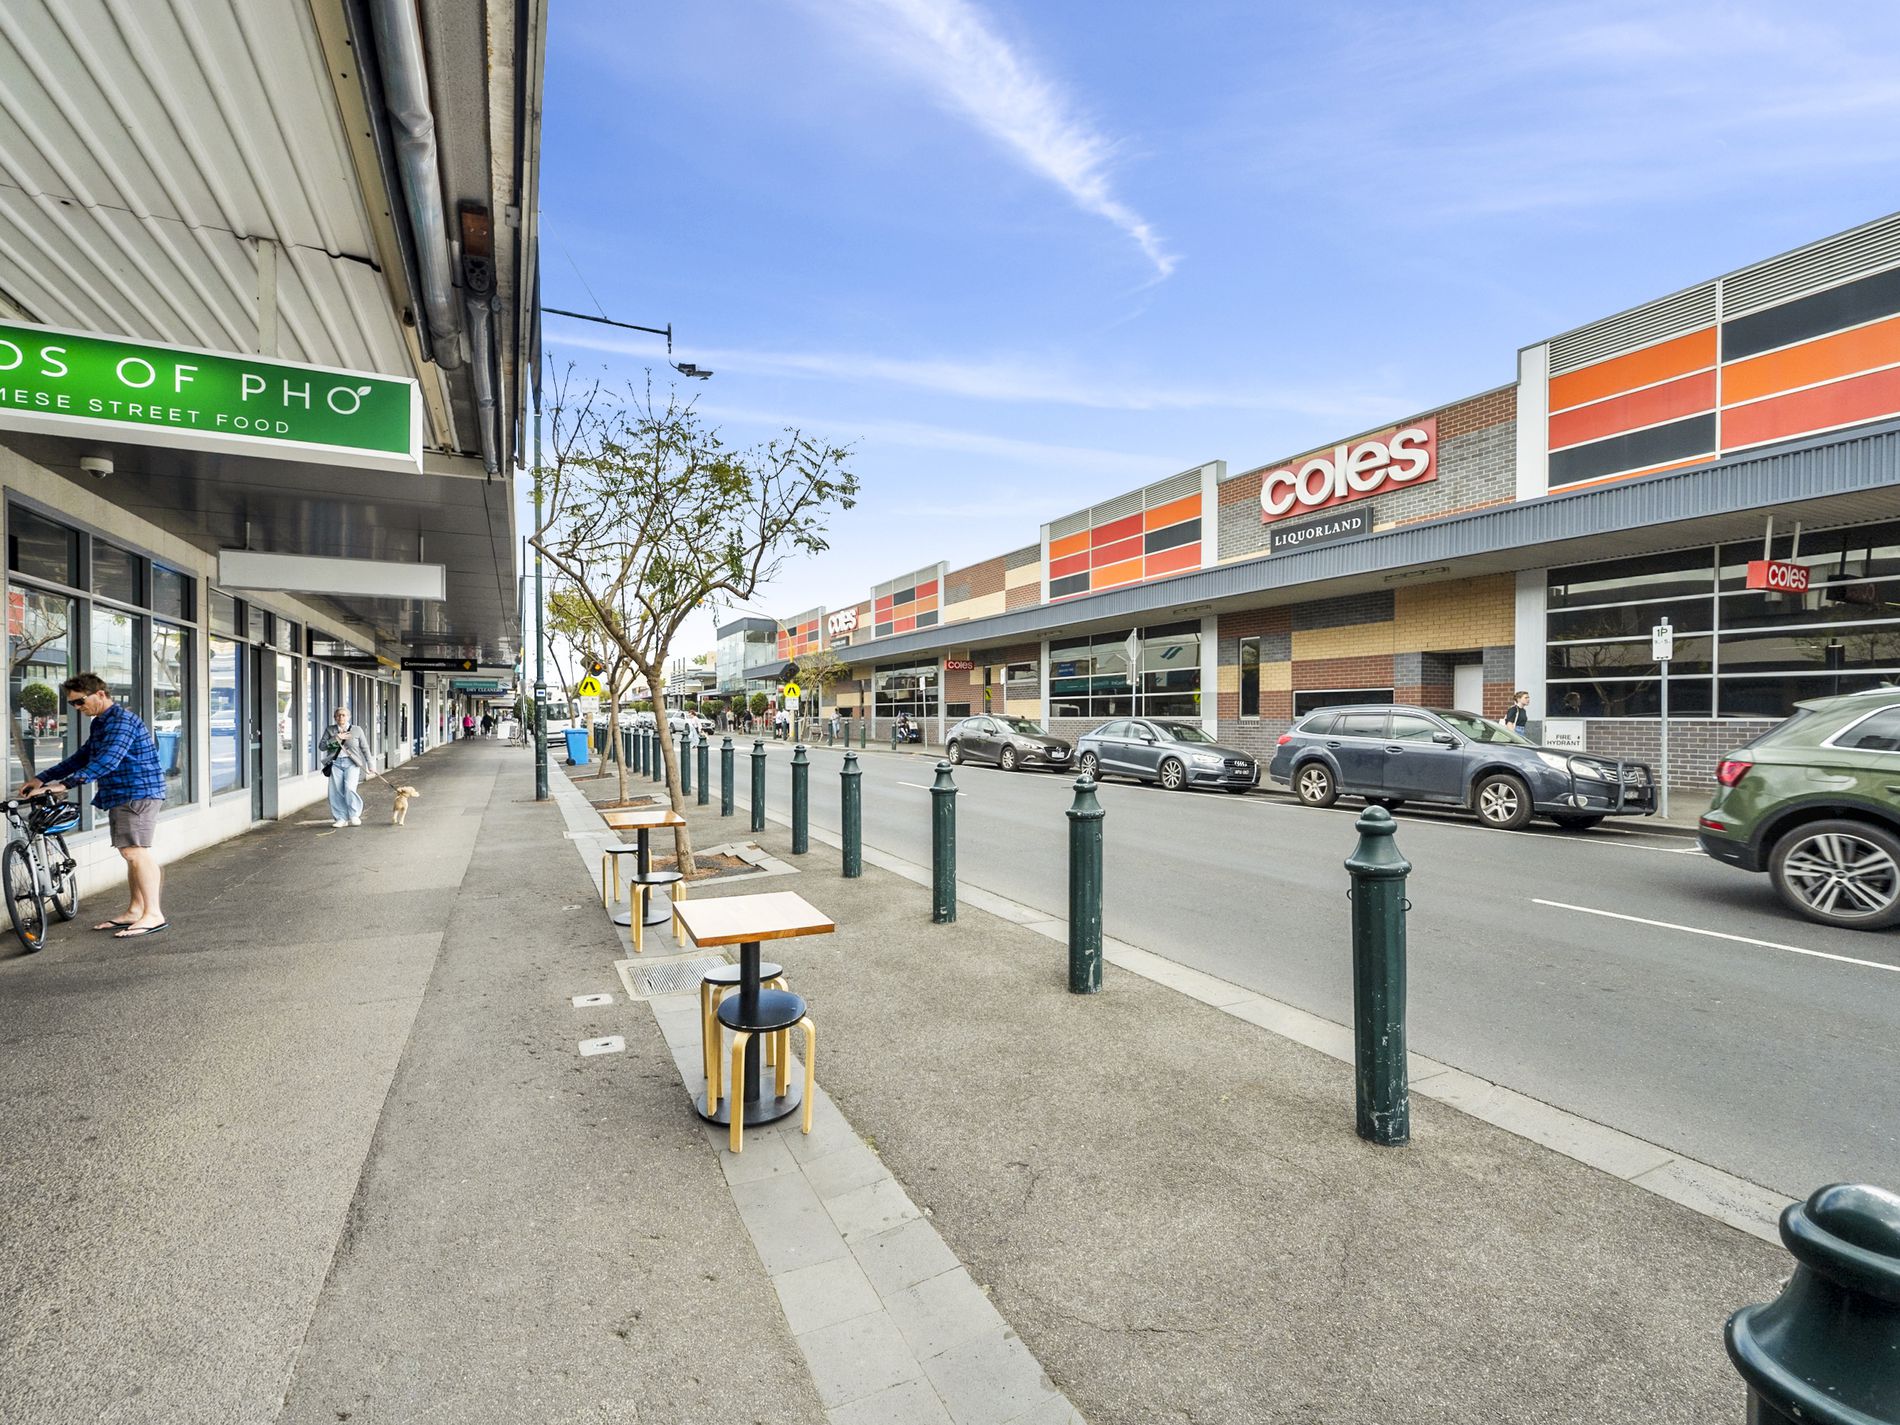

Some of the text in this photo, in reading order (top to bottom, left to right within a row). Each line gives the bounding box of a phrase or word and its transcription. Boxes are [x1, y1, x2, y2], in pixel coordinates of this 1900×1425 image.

[116, 357, 199, 393] OF
[242, 373, 361, 415] PHO
[89, 398, 200, 424] STREET
[216, 413, 289, 434] FOOD
[1260, 428, 1430, 516] coles
[1274, 517, 1363, 546] LIQUORLAND
[1768, 564, 1807, 590] coles
[828, 609, 857, 634] coles
[947, 661, 973, 670] coles
